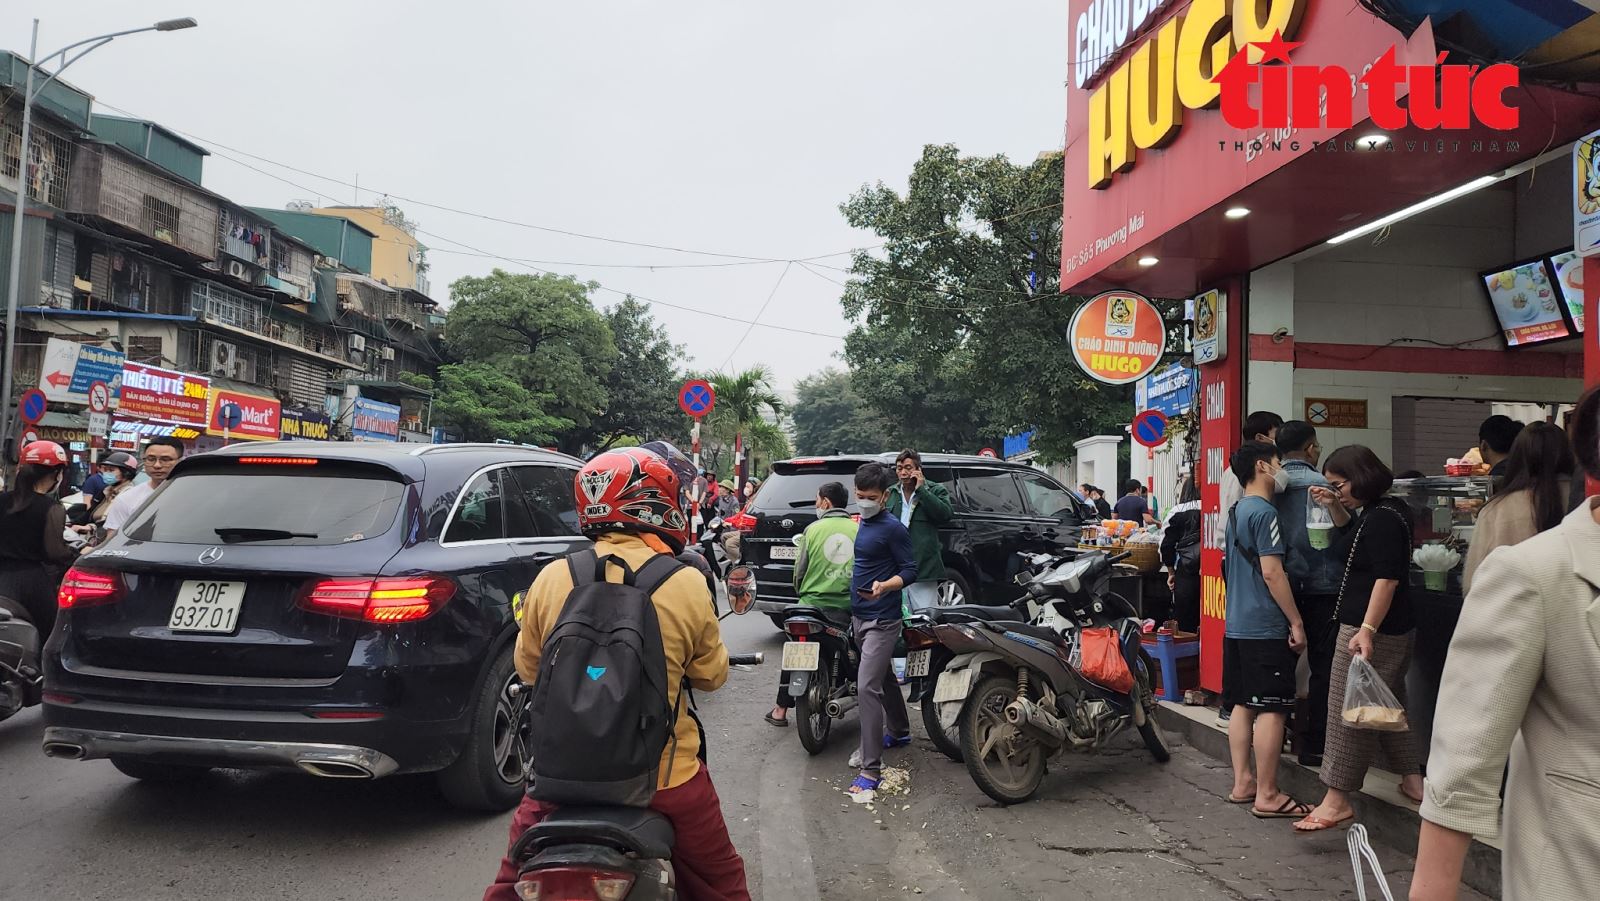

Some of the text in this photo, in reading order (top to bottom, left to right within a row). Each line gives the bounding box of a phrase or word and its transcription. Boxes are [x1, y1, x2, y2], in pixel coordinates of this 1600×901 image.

[1095, 225, 1127, 256] Phương
[1128, 211, 1145, 235] Mai
[1078, 336, 1159, 356] CHÁO DINH DƯỠNG
[1091, 354, 1142, 373] HUGO
[122, 368, 149, 389] THIẾT
[152, 376, 162, 395] BỊ
[163, 378, 170, 393] Y
[172, 375, 184, 396] TẾ
[1206, 374, 1225, 420] CHÁO
[282, 415, 300, 436] NHÀ
[302, 418, 328, 439] THUỐC
[1207, 447, 1224, 485] DINH
[586, 505, 607, 515] INDEX
[824, 566, 853, 579] Grab
[192, 582, 230, 604] 30F
[172, 605, 234, 629] 937.01
